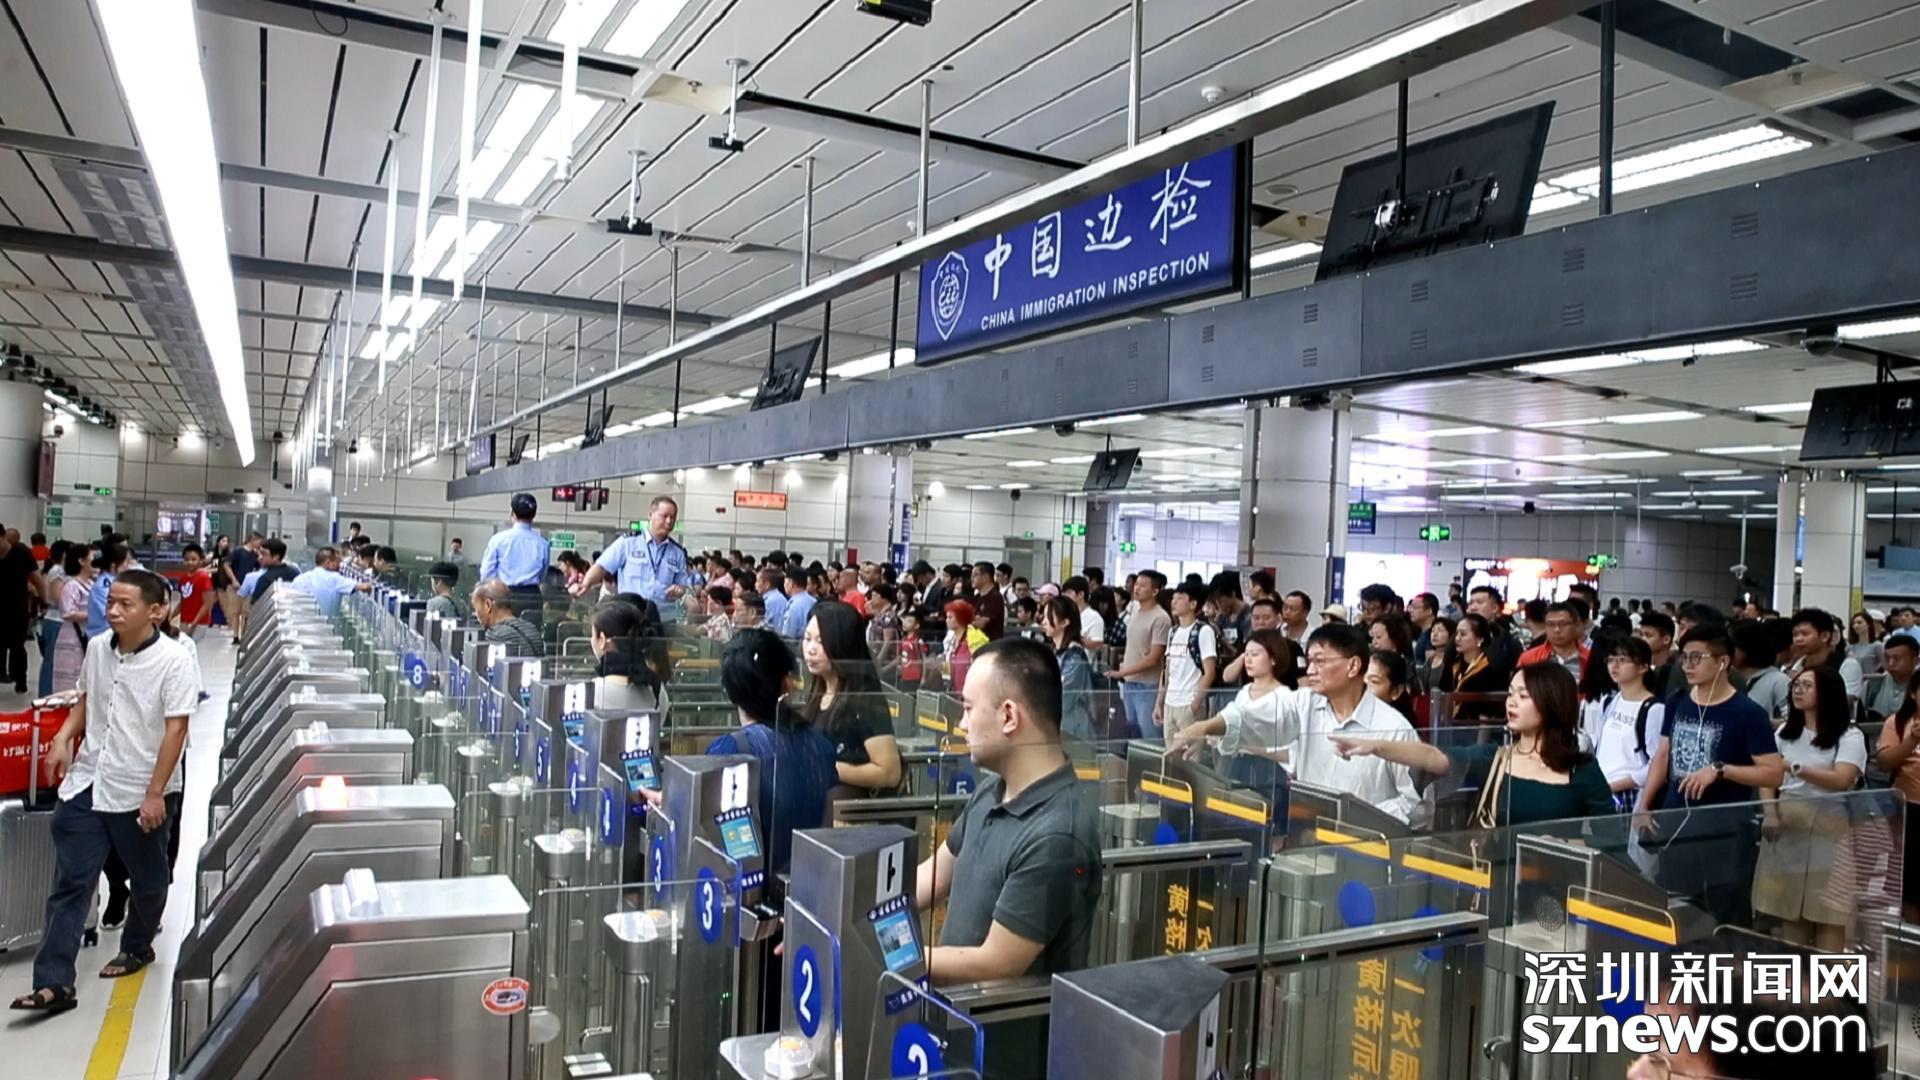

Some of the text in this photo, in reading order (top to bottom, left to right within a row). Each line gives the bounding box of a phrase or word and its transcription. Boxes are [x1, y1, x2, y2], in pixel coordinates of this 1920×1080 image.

[984, 161, 1211, 300] 中国边检
[981, 251, 1209, 331] CHINA IMMIGRATION INSPECTION
[413, 664, 423, 686] 8
[654, 847, 662, 893] 3
[702, 881, 714, 931] 3
[800, 959, 813, 1023] 2
